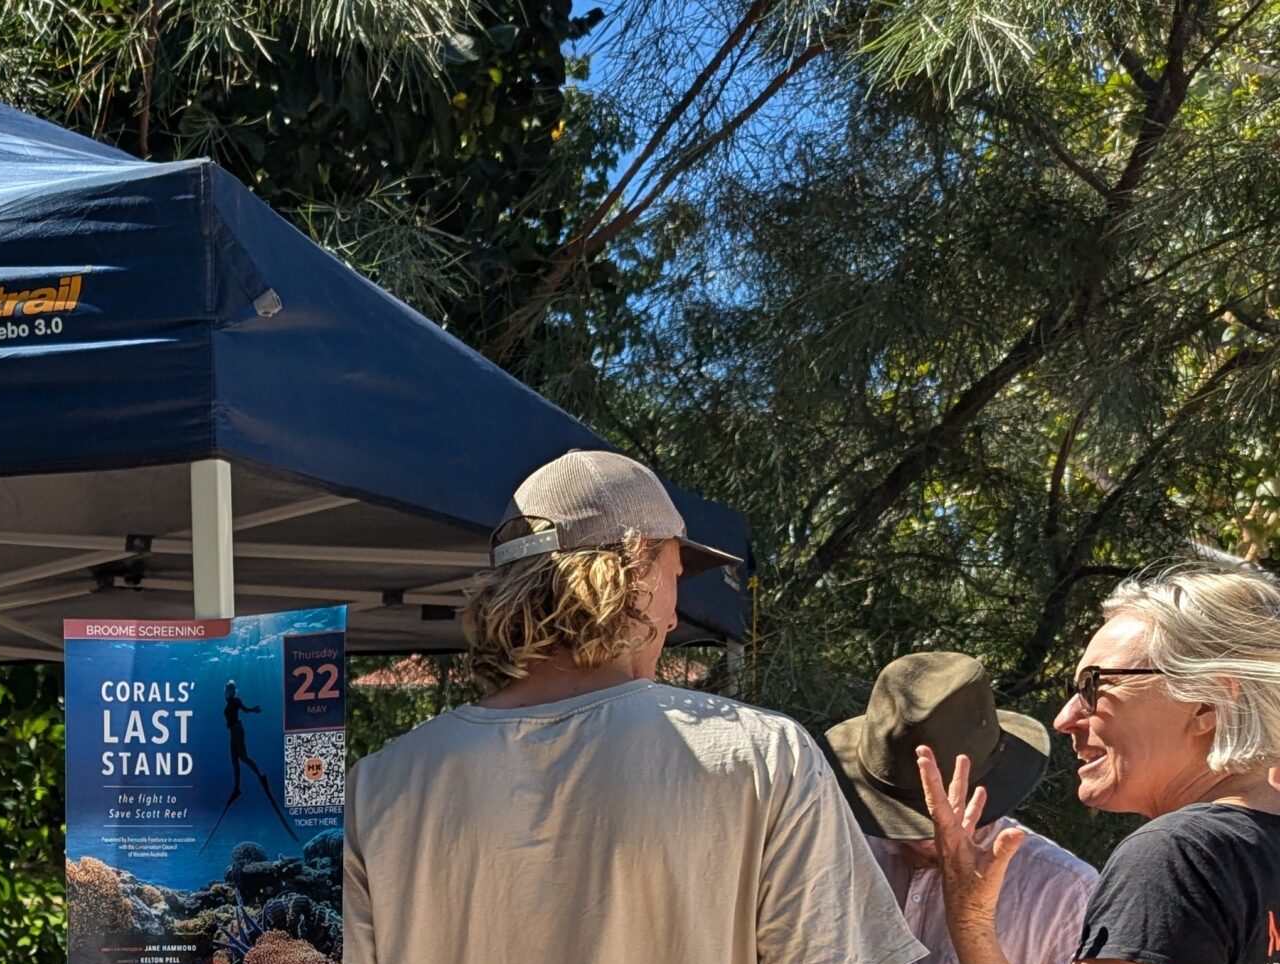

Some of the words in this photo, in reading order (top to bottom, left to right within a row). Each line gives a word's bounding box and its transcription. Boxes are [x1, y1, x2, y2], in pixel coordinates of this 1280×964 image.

[34, 317, 63, 335] 3.0
[86, 625, 136, 637] BROOME
[138, 625, 206, 637] SCREENING
[292, 648, 338, 660] Thursday
[292, 663, 340, 701] 22
[101, 681, 196, 703] CORALS'
[307, 704, 328, 714] MAY
[103, 710, 194, 745] LAST
[101, 752, 194, 777] STAND
[118, 794, 135, 804] the
[138, 794, 164, 806] fight
[167, 795, 177, 804] to
[108, 808, 131, 819] Save
[135, 808, 161, 819] Scott
[164, 808, 188, 819] Reef
[289, 807, 303, 816] GET
[303, 806, 324, 815] YOUR
[324, 805, 343, 814] FREE
[294, 818, 317, 827] TICKET
[319, 817, 338, 826] HERE
